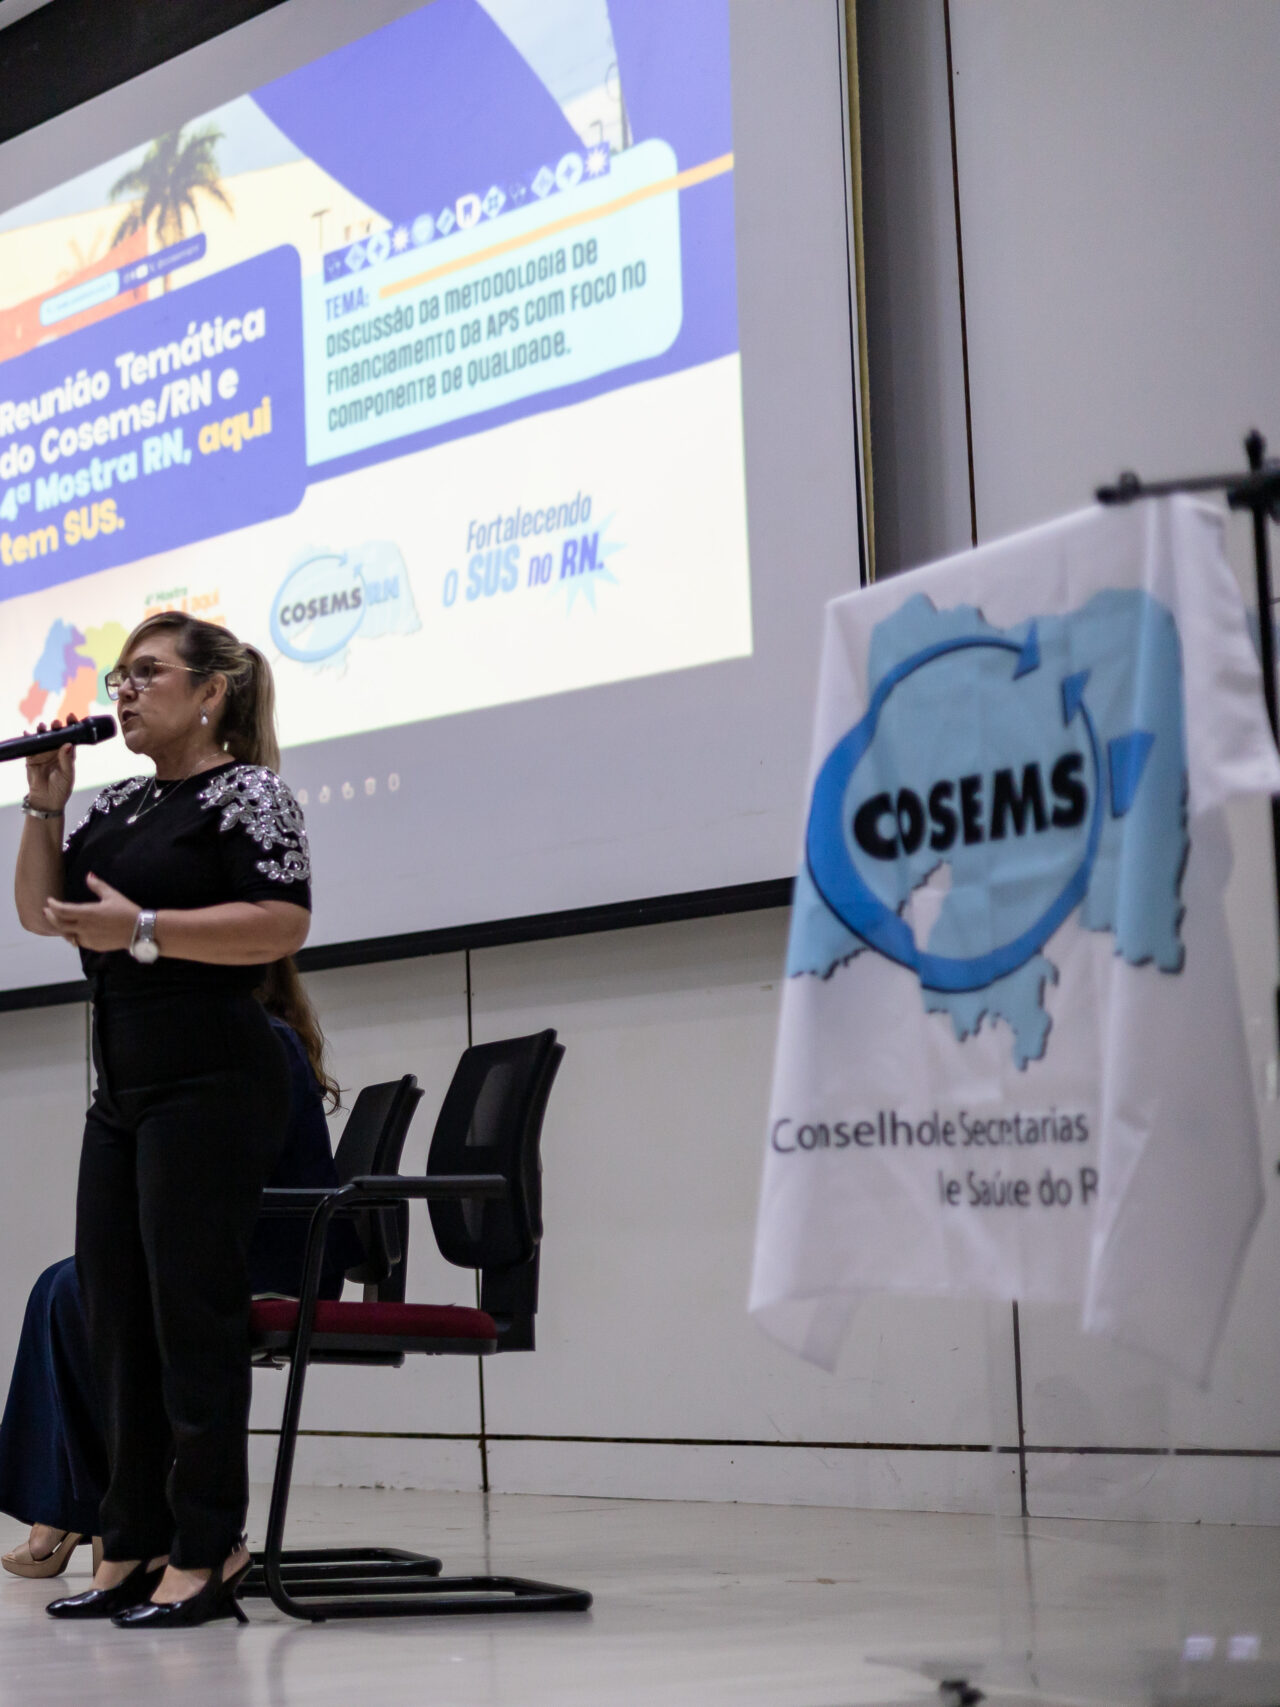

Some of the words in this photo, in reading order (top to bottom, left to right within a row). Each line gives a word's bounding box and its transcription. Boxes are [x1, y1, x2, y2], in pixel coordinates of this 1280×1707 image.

[325, 285, 370, 322] TEMA:
[485, 305, 520, 340] APS
[114, 306, 267, 391] Temática
[40, 368, 213, 465] Cosems/RN
[217, 367, 240, 400] e
[34, 449, 139, 513] Mostra
[141, 426, 193, 477] RN,
[197, 395, 273, 455] aqui
[0, 523, 60, 567] tem
[63, 497, 126, 547] SUS.
[465, 489, 593, 554] Fortalecendo
[465, 543, 521, 602] SUS
[527, 552, 553, 589] no
[559, 530, 605, 581] RN.
[278, 585, 363, 628] COSEMS
[853, 751, 1089, 861] COSEMS
[1038, 1167, 1073, 1207] do
